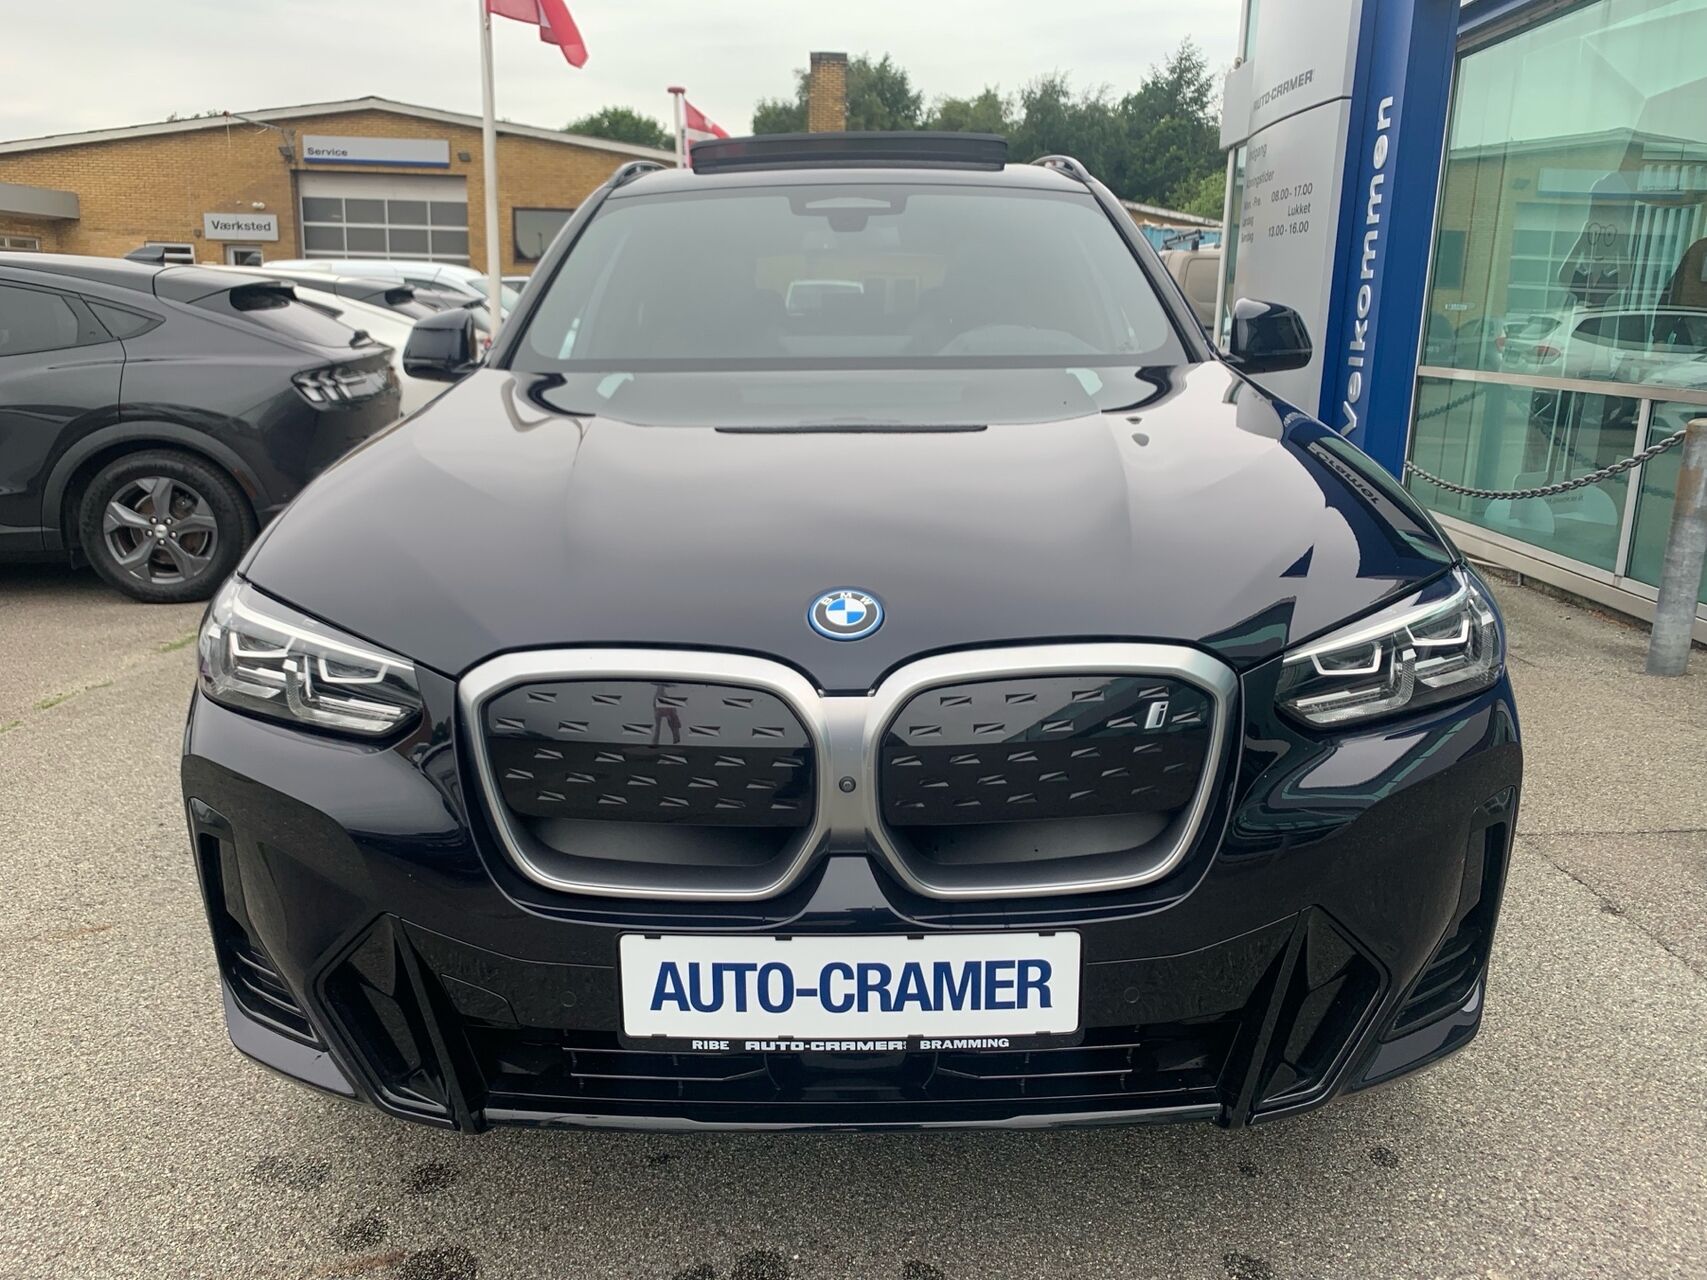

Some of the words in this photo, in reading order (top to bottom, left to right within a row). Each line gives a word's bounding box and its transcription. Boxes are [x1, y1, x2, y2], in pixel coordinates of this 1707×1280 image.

[307, 147, 348, 157] Service
[1294, 182, 1313, 198] 17.00
[1288, 202, 1311, 217] Lukket
[211, 219, 272, 232] Værksted
[1289, 220, 1310, 234] 16.00
[1340, 96, 1394, 436] Velkommen
[821, 592, 873, 606] BMW
[650, 958, 1053, 1014] AUTO-CRAMER
[692, 1039, 730, 1050] RIBE
[745, 1039, 904, 1052] AUTO-CRAMER
[919, 1038, 1010, 1050] BRAMMING
